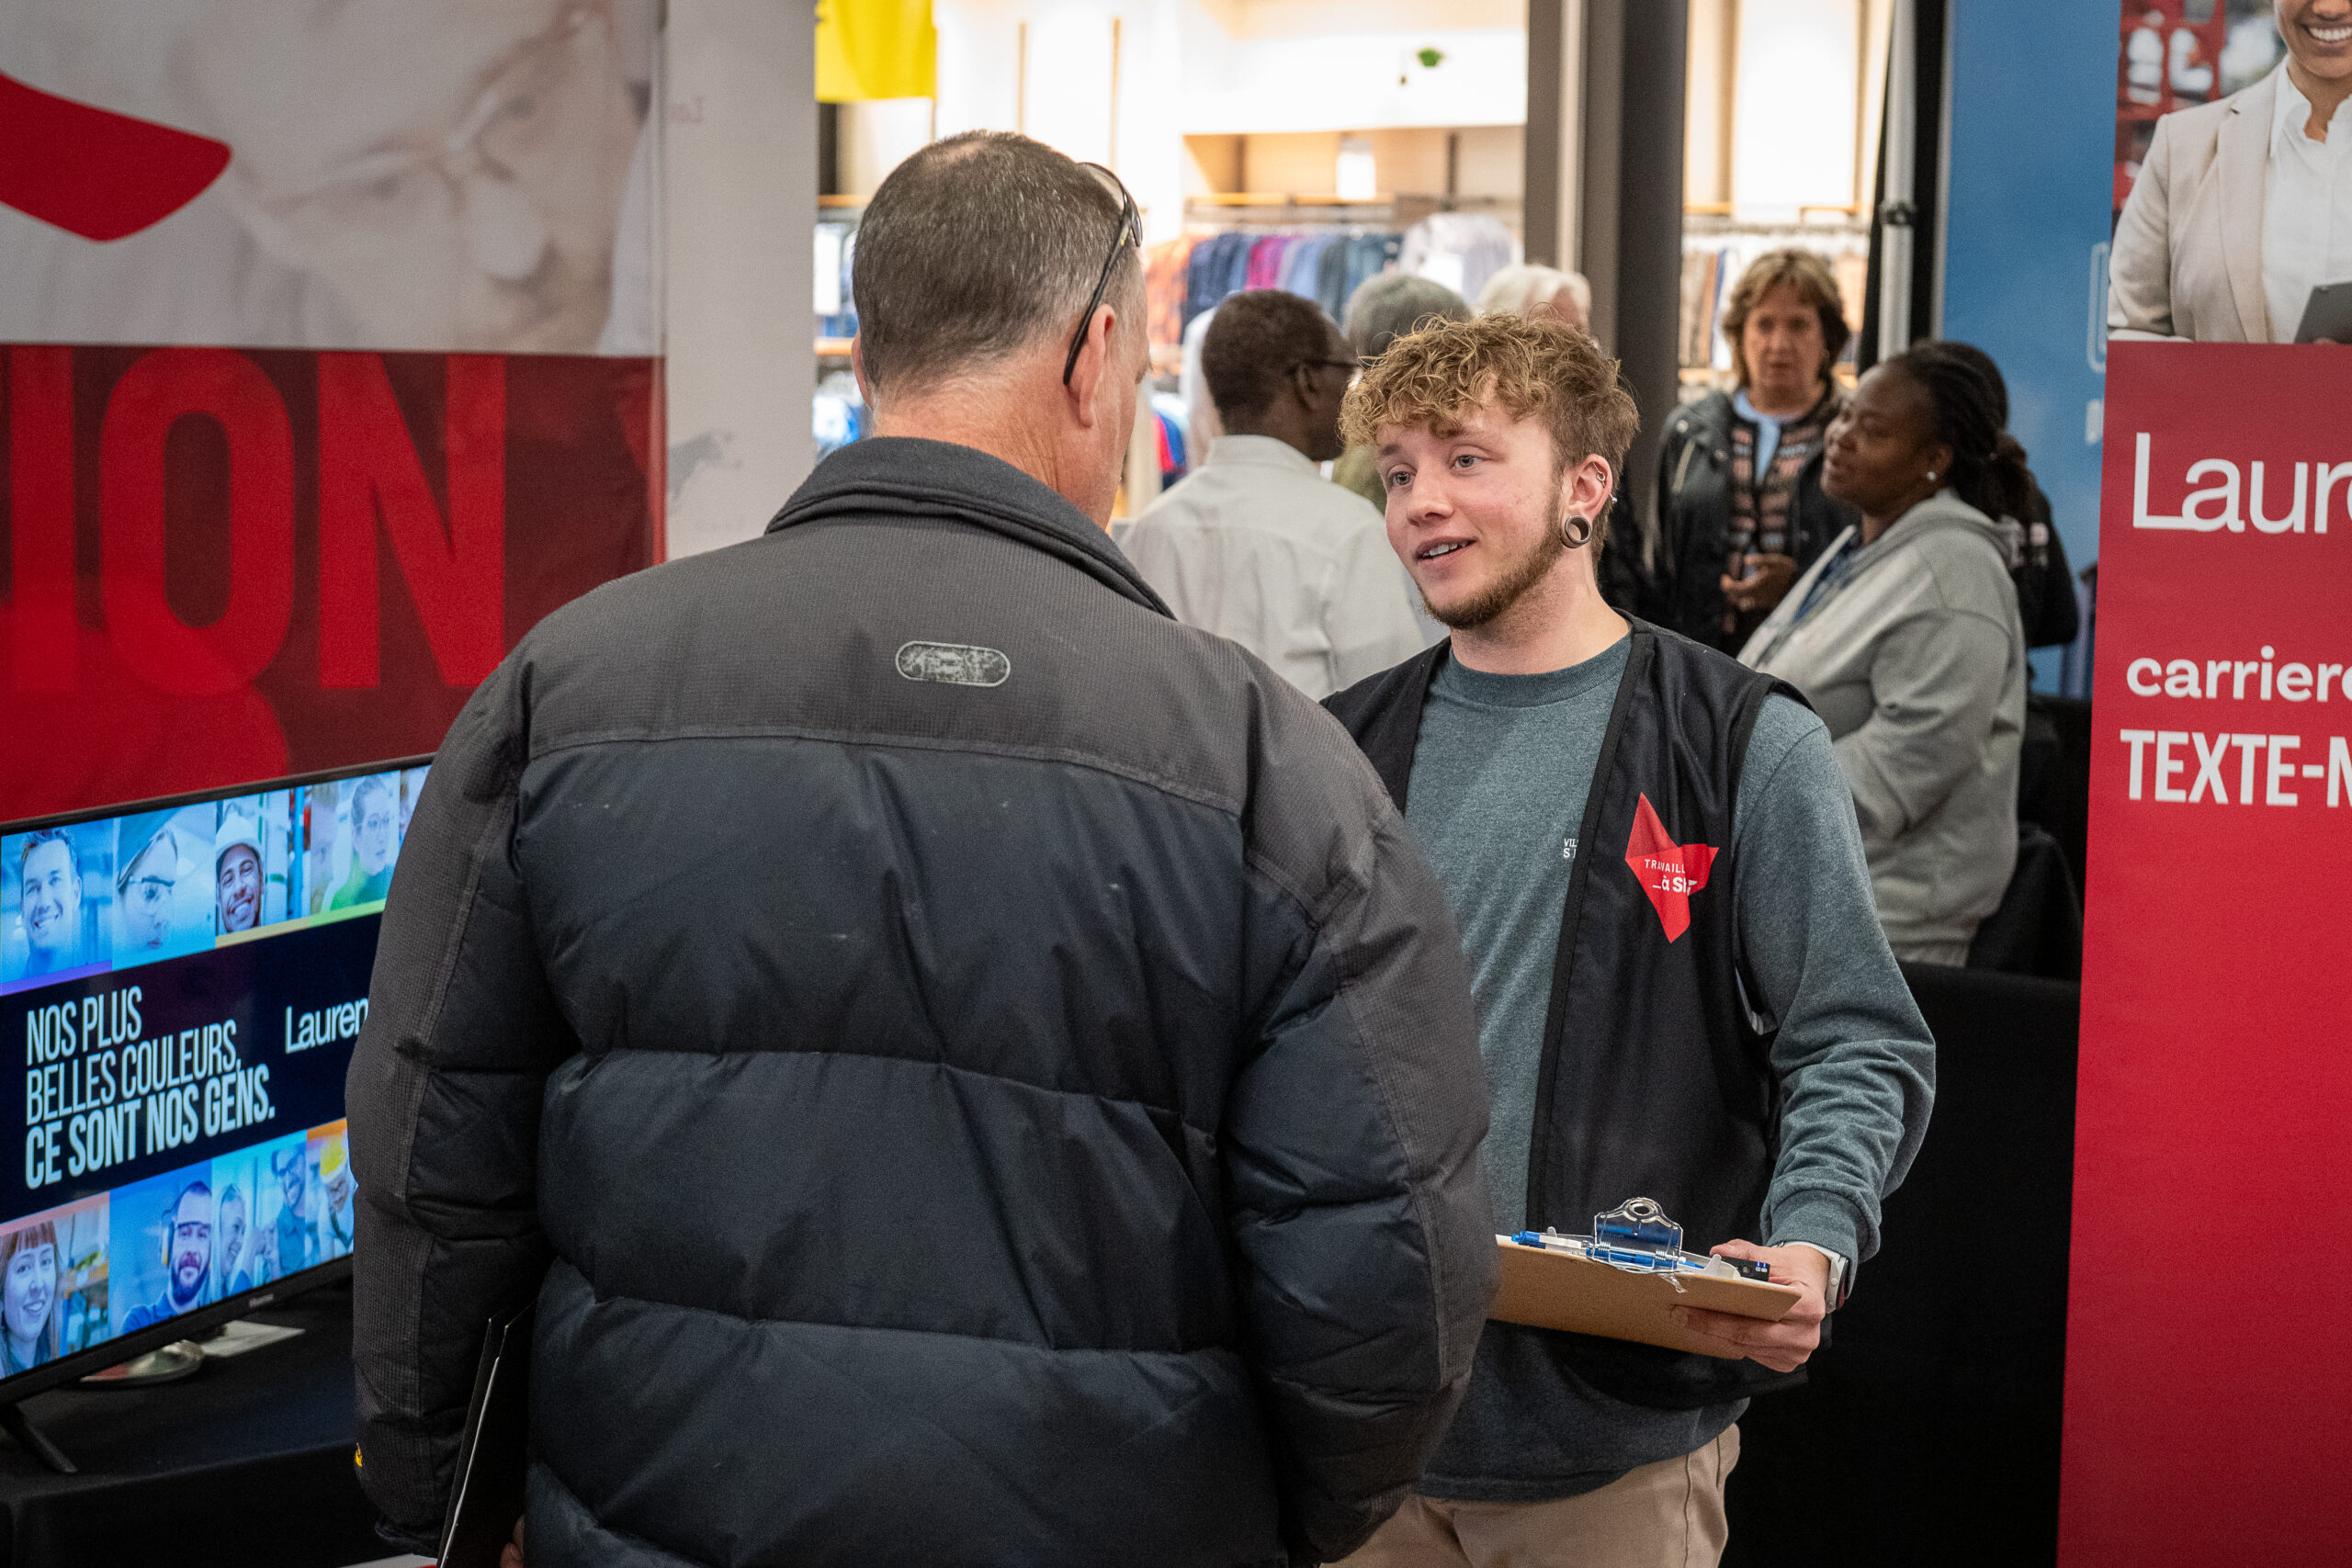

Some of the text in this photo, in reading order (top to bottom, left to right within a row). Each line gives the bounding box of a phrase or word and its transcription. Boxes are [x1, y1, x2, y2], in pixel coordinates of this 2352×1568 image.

[2132, 432, 2352, 535] Laur
[2126, 645, 2352, 703] carrier
[27, 986, 142, 1066] NOS PLUS
[27, 1019, 243, 1126] BELLES COULEURS,
[25, 1063, 276, 1190] CE SONT NOS GENS.
